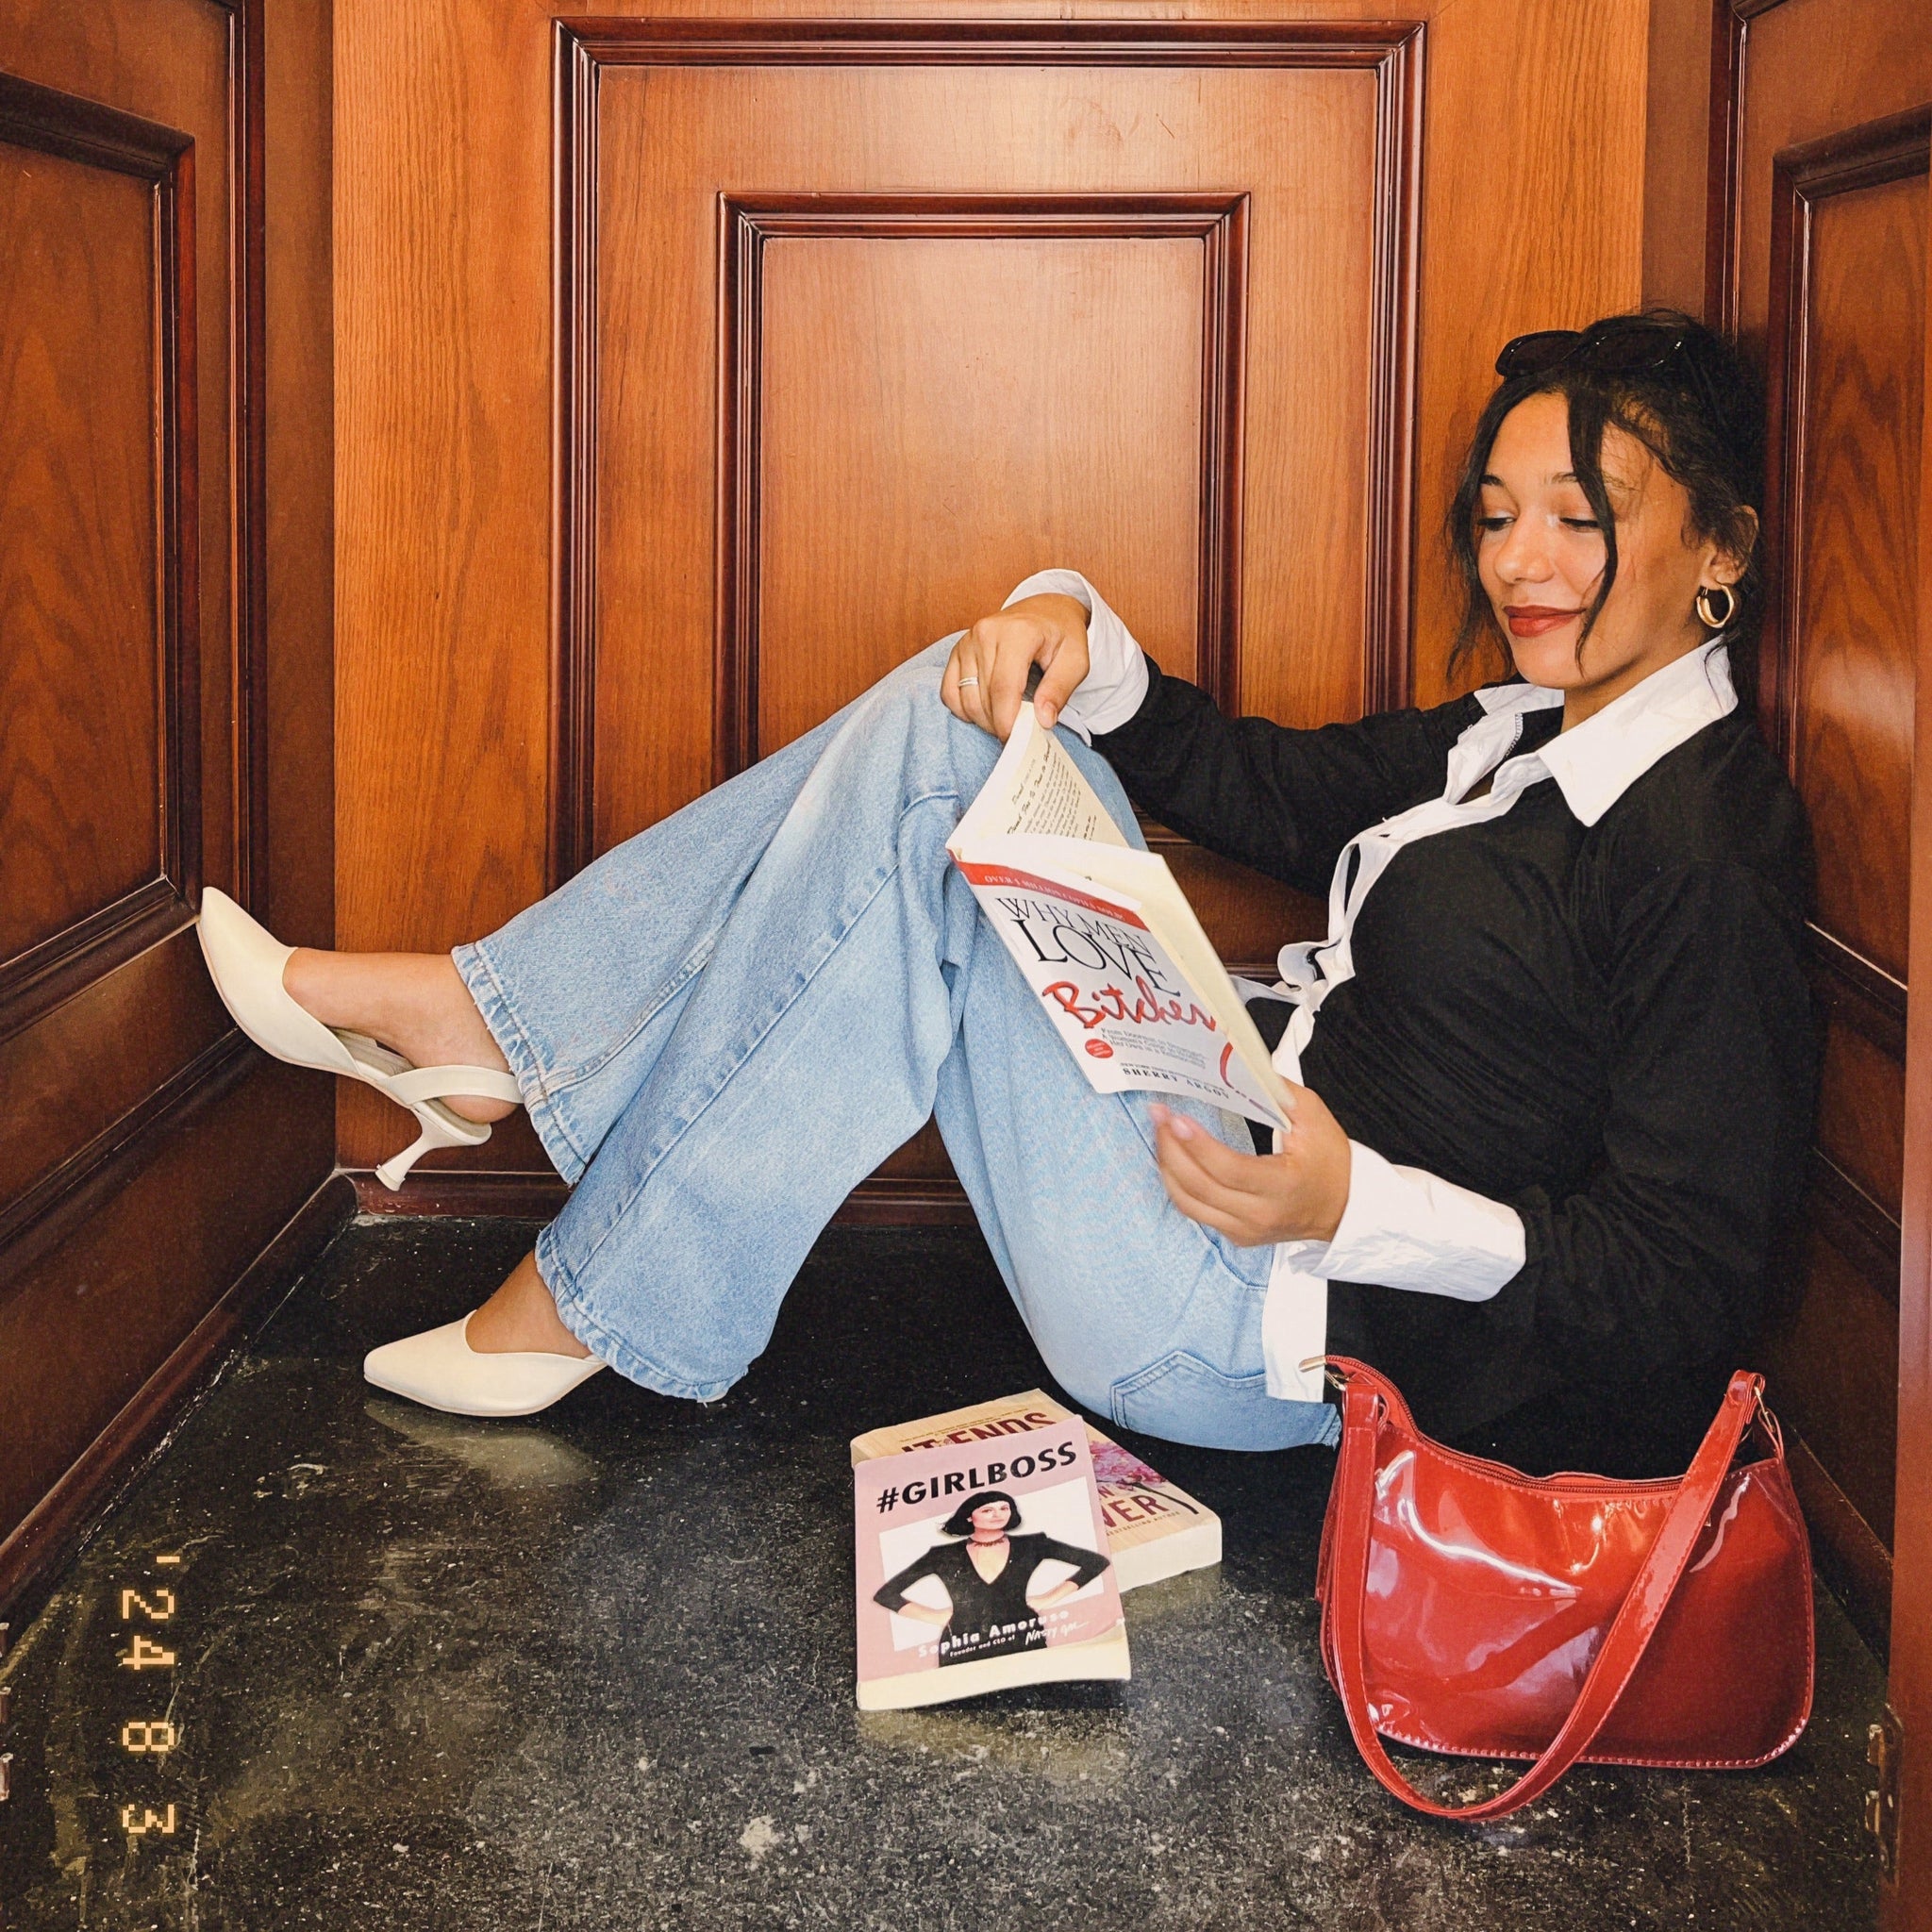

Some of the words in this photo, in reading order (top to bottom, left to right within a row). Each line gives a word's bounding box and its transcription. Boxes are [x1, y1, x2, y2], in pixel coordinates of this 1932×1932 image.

[995, 897, 1074, 928] WHY
[1077, 912, 1153, 958] MEN
[1010, 918, 1181, 997] LOVE
[1123, 1067, 1178, 1083] SHERRY
[875, 1441, 1077, 1514] #GIRLBOSS
[918, 1631, 980, 1658] Sophia
[989, 1609, 1070, 1640] Amoruso
